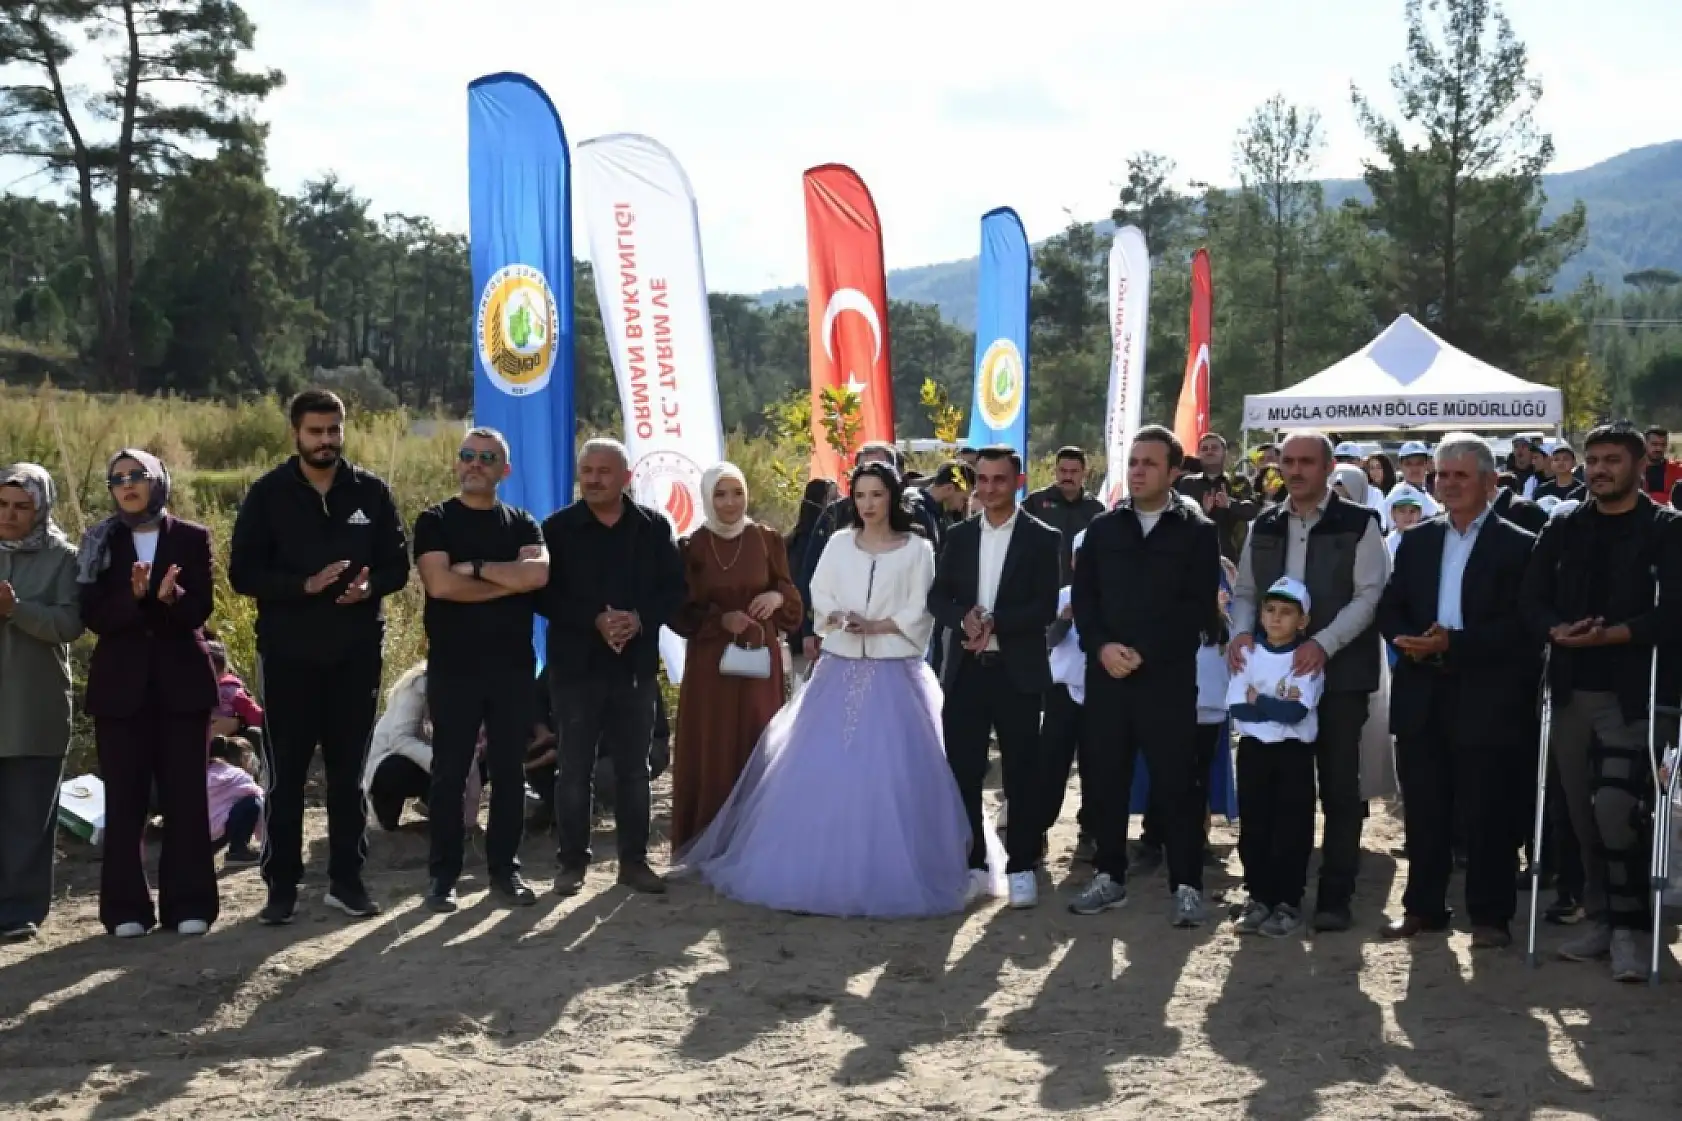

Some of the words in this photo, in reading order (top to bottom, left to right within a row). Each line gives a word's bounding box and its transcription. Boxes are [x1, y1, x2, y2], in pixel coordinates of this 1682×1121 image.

[1268, 404, 1322, 421] MUĞLA
[1325, 403, 1382, 419] ORMAN
[1385, 399, 1439, 417] BÖLGE
[1442, 400, 1548, 418] MÜDÜRLÜĞÜ
